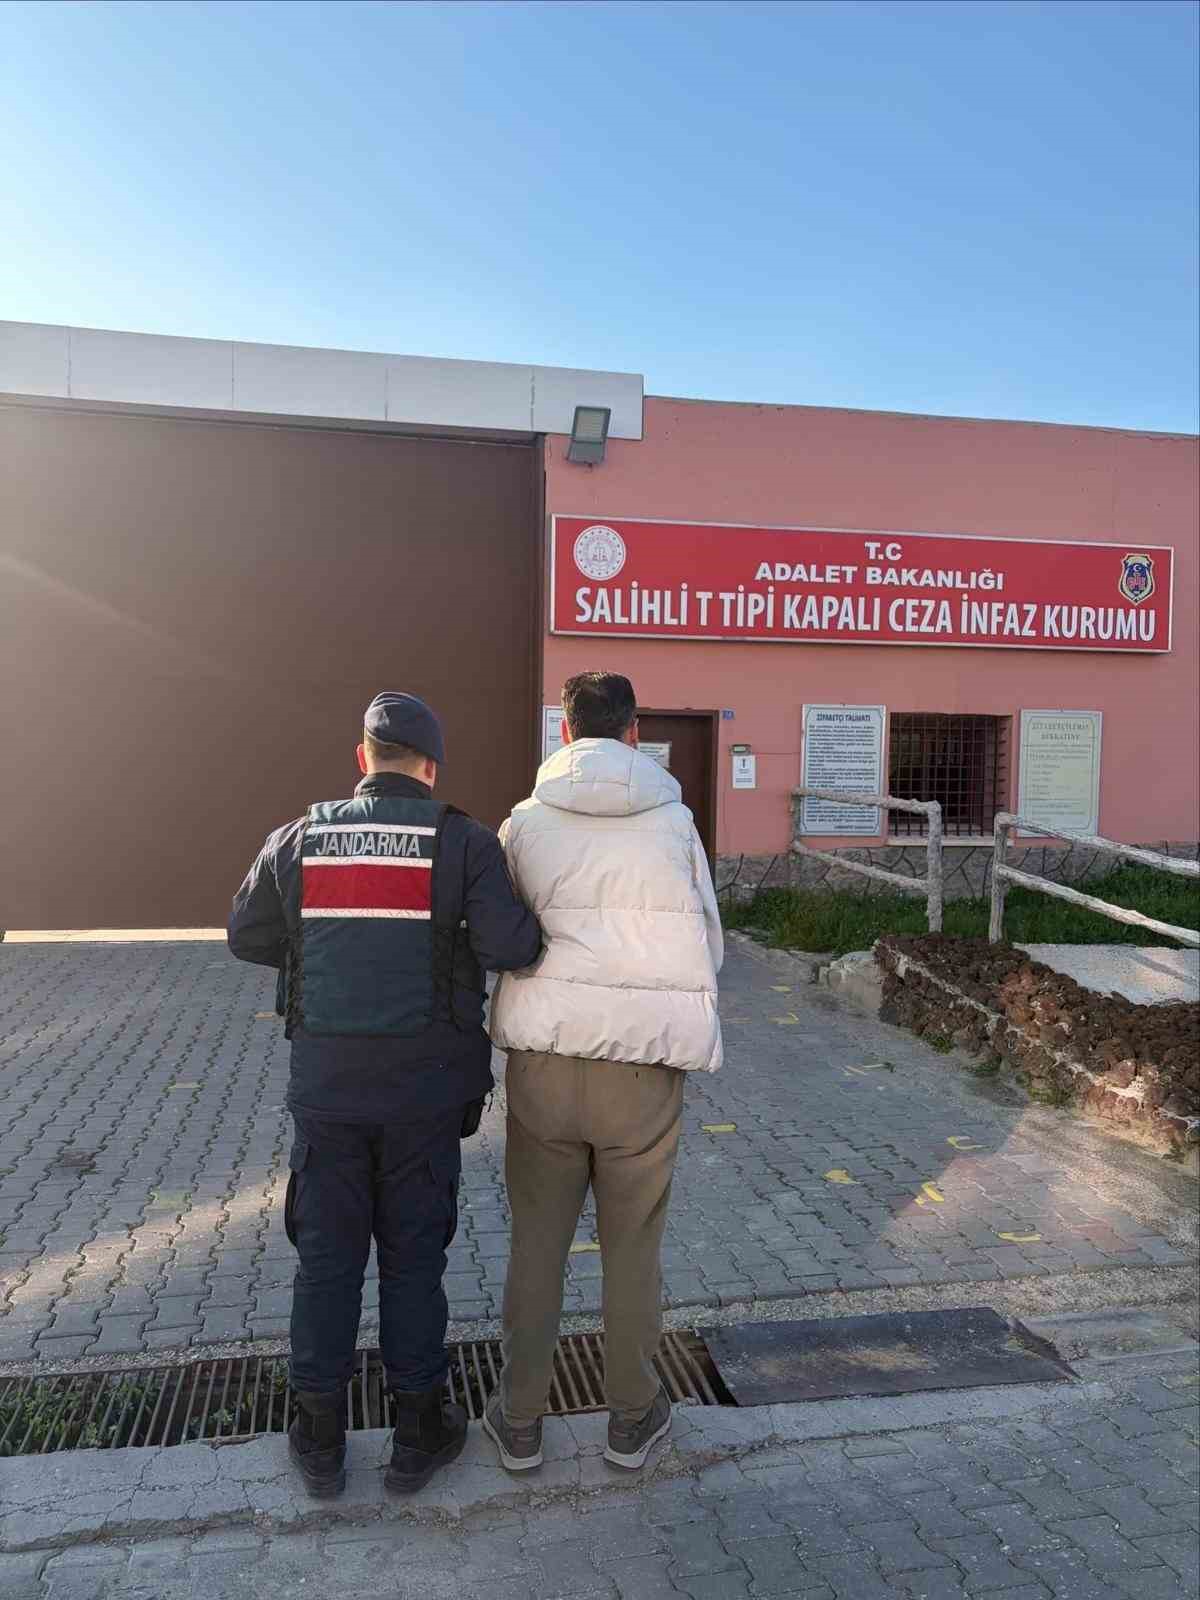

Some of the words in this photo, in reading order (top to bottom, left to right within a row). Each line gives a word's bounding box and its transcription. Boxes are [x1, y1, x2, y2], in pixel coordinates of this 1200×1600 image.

[864, 541, 903, 561] T.C
[754, 562, 859, 583] ADALET
[865, 566, 1005, 590] BAKANLIĞI
[575, 581, 688, 626] SALİHLİ
[695, 591, 713, 626] T
[718, 584, 775, 628] TİPİ
[783, 593, 881, 632] KAPALI
[888, 598, 953, 634] CEZA
[960, 593, 1037, 637] İNFAZ
[1043, 604, 1156, 642] KURUMU
[315, 832, 421, 857] JANDARMA
